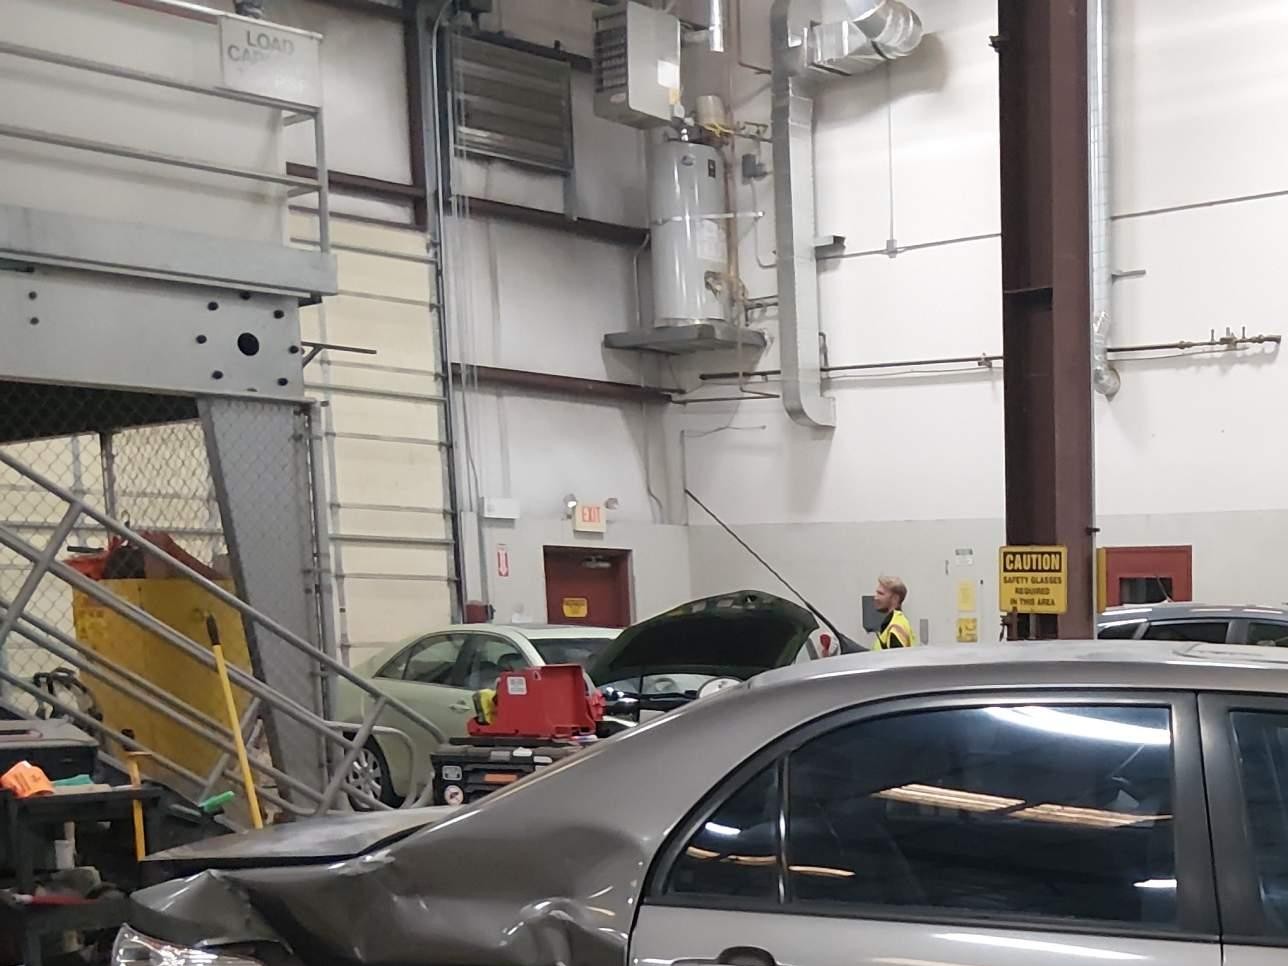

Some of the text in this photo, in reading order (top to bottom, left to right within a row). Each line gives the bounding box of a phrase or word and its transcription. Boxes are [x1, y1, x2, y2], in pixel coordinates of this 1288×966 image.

[246, 30, 295, 56] LOAD
[582, 506, 601, 522] EXIT
[1005, 553, 1060, 570] CAUTION
[1003, 576, 1062, 584] SAFETY GLASSES
[1010, 598, 1018, 606] IN
